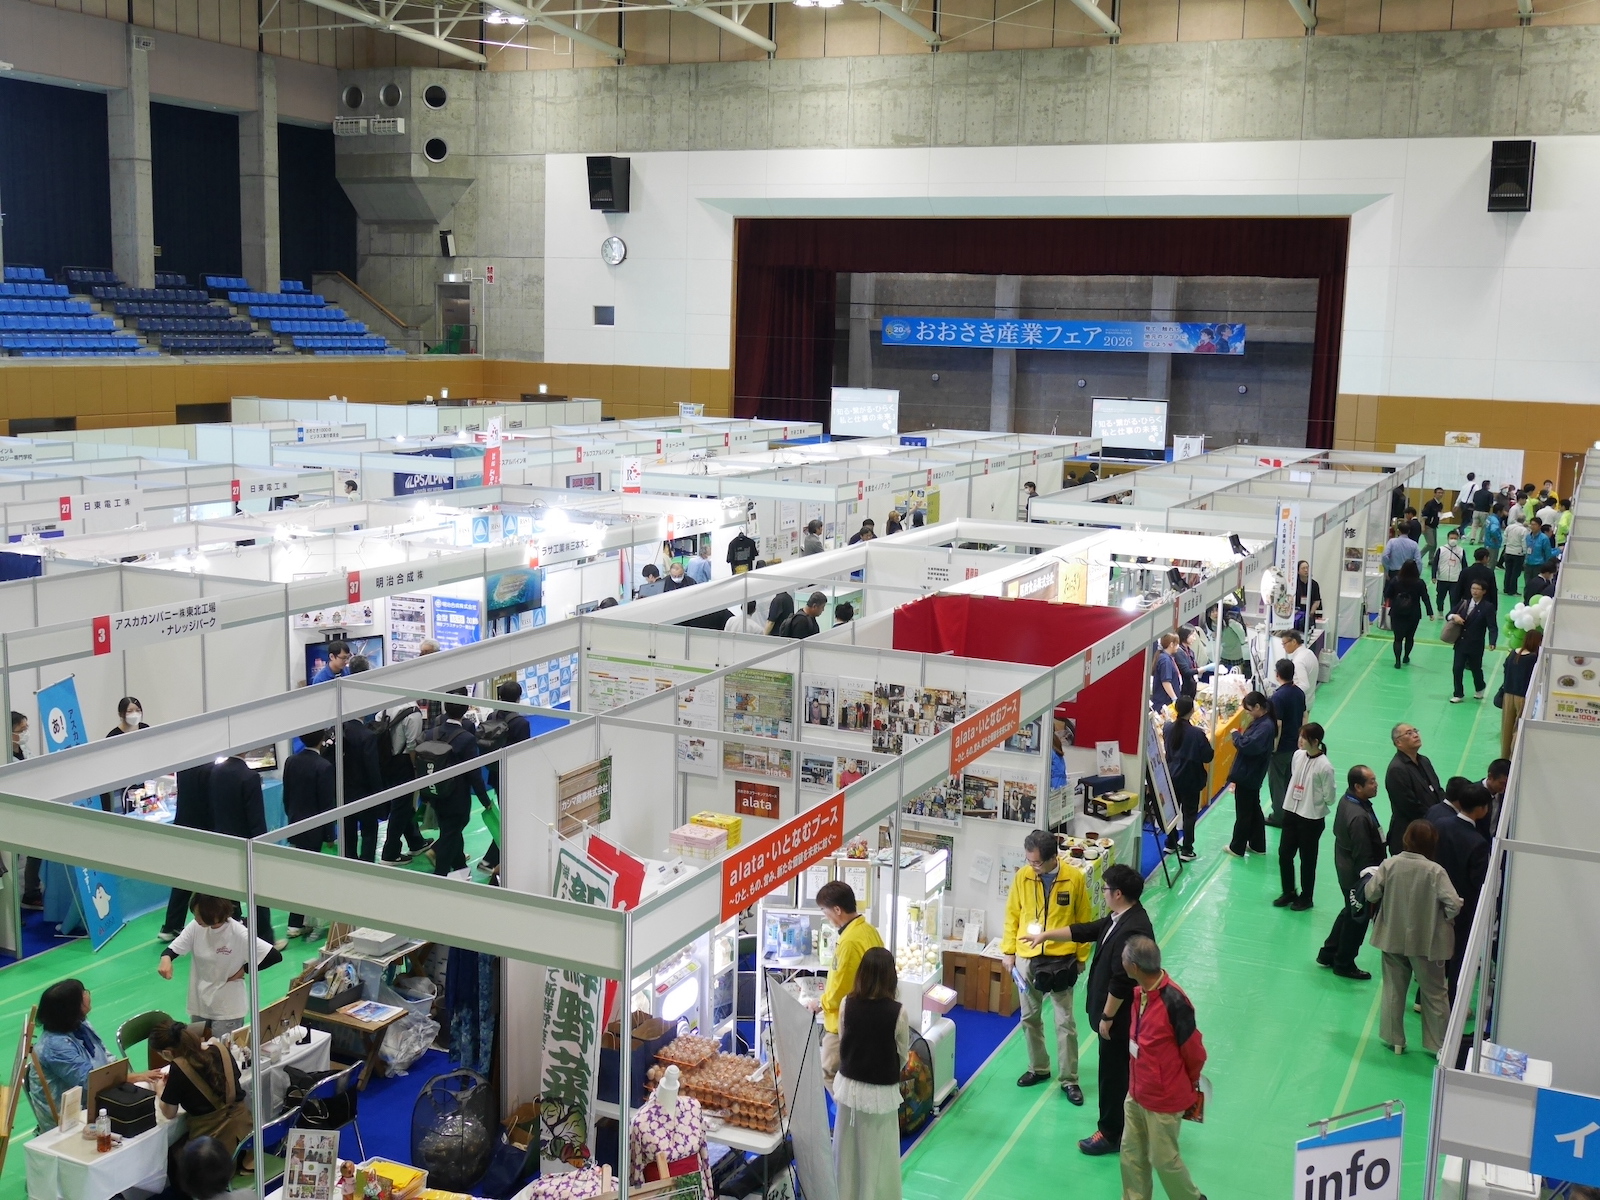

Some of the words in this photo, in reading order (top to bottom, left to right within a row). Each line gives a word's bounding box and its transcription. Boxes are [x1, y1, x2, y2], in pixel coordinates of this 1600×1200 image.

[916, 321, 1102, 346] おおさき産業フェア
[1103, 336, 1133, 347] 2026
[233, 486, 240, 496] 27
[61, 503, 71, 514] 27
[349, 581, 359, 594] 37
[97, 628, 106, 643] 3
[765, 768, 788, 778] alata
[742, 796, 772, 811] alata
[729, 805, 839, 887] alata・いとなむブース
[1554, 1122, 1600, 1159] イ
[1304, 1149, 1391, 1200] info
